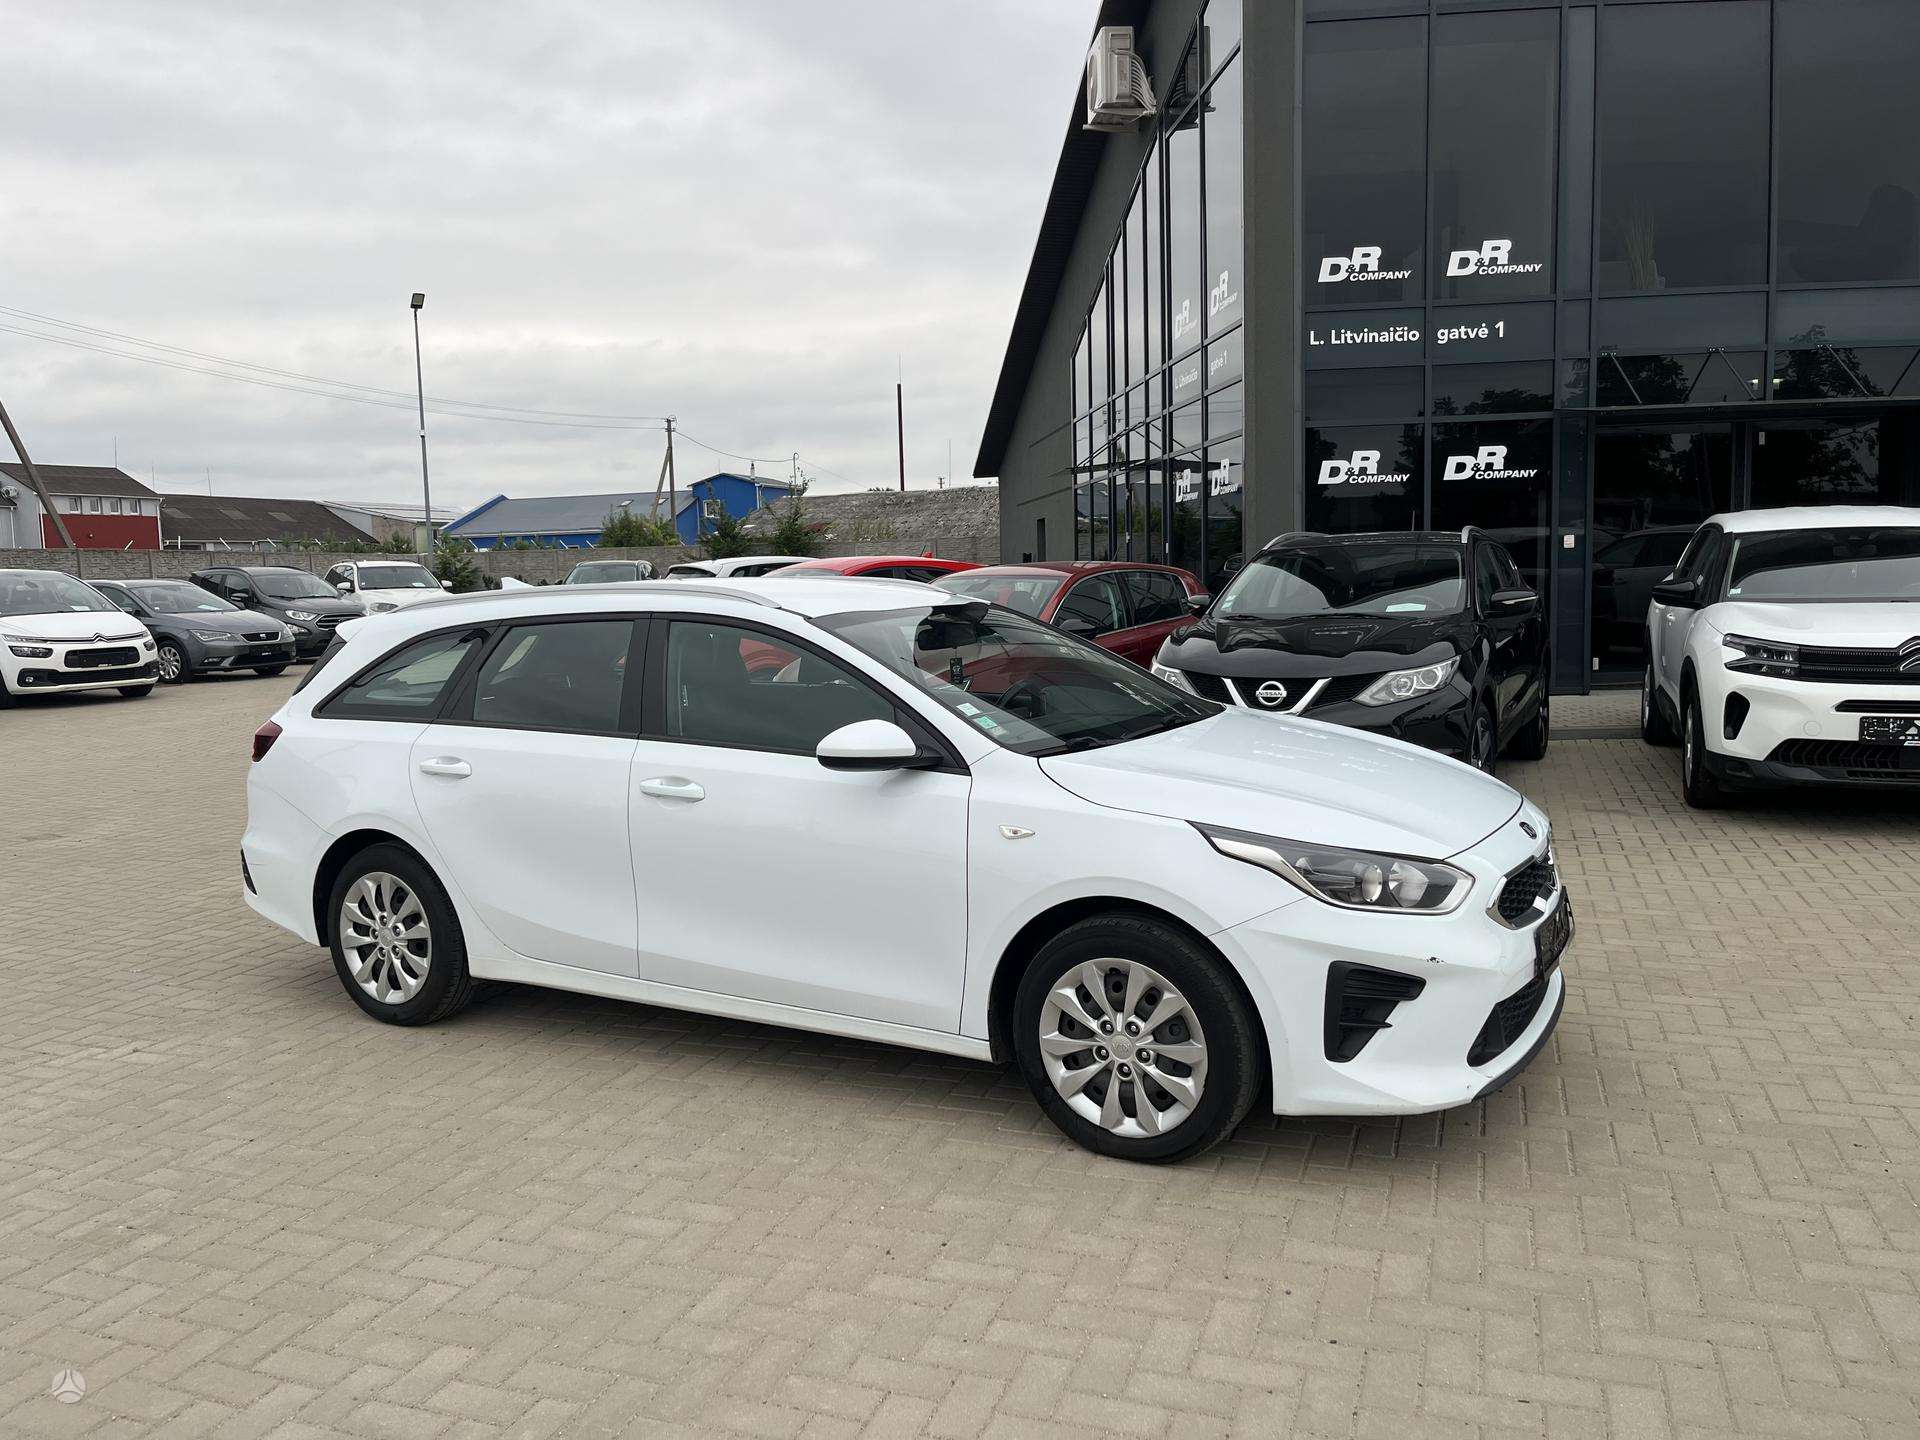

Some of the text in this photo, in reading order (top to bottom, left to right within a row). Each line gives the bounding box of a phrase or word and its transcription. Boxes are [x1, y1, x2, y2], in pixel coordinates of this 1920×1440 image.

[1478, 263, 1543, 275] COMPANY
[1349, 270, 1411, 282] COMPANY
[1310, 321, 1505, 346] L. Litvinaičio gatvė 1
[1348, 473, 1410, 484] COMPANY
[1475, 469, 1538, 480] COMPANY
